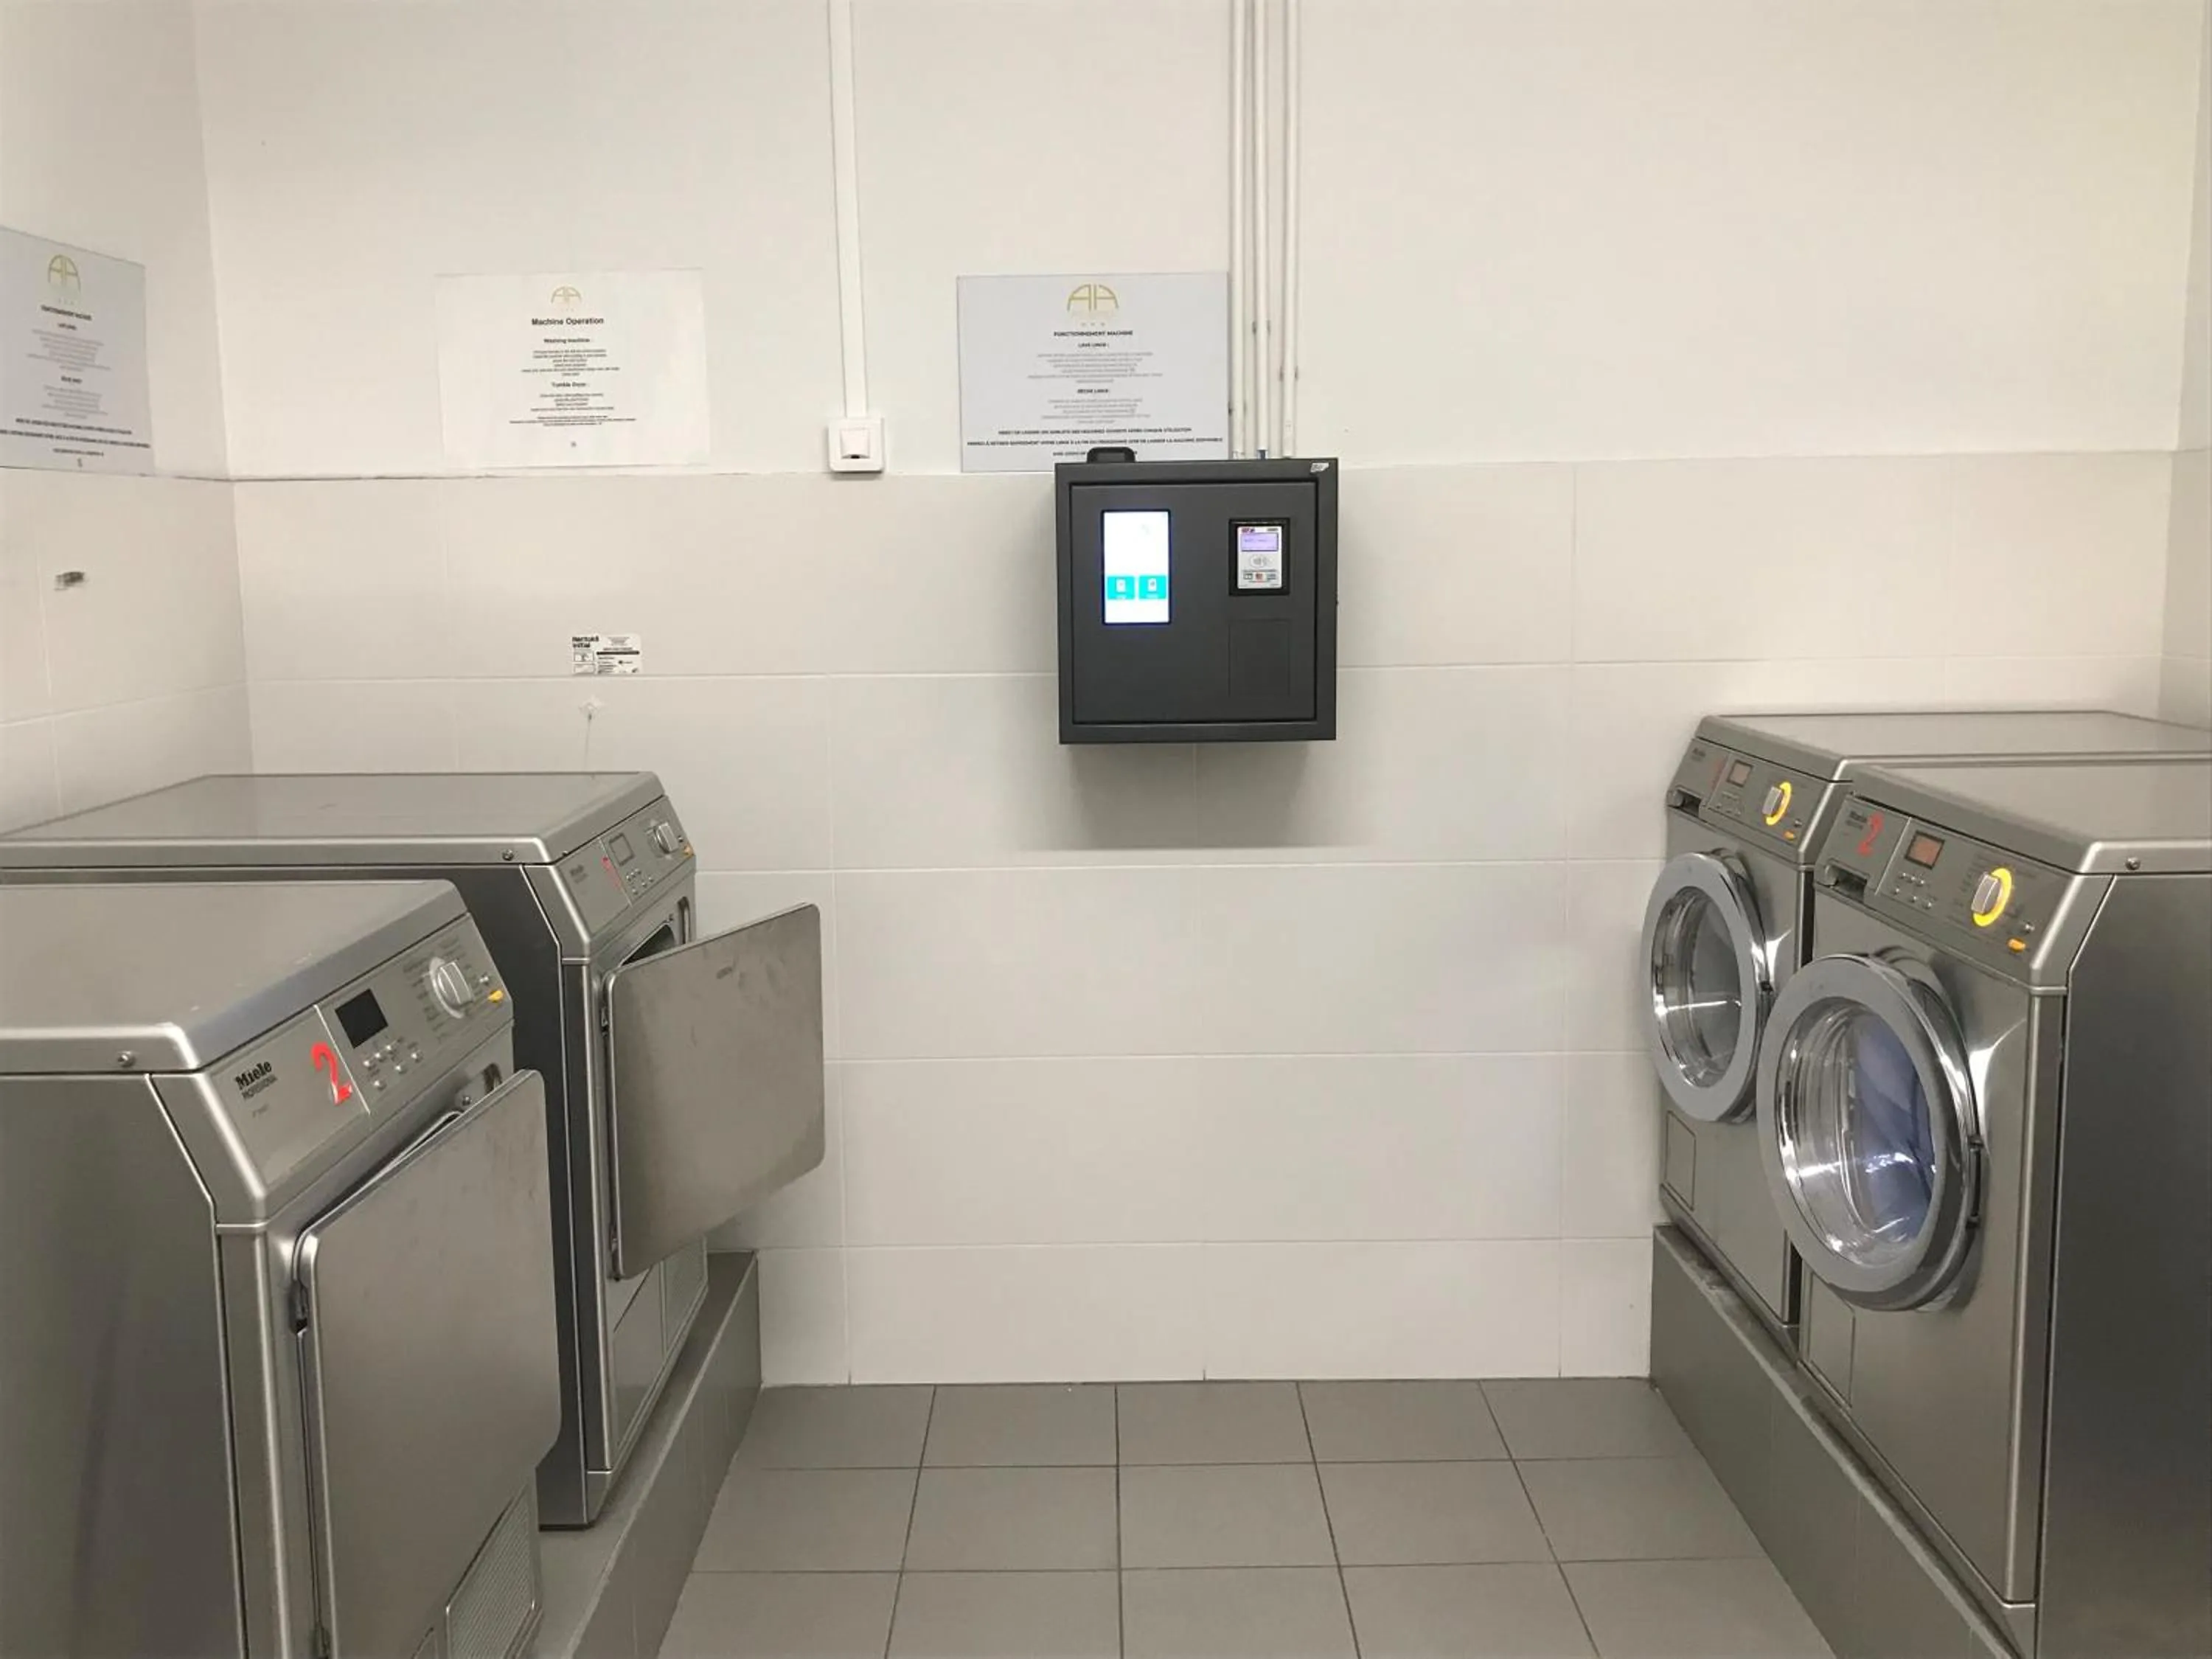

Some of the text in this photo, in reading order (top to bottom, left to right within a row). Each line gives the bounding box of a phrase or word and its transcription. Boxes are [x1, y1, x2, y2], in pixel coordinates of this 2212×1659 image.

[566, 317, 604, 326] Operation
[1856, 810, 1885, 856] 2
[235, 1061, 272, 1090] Miele
[310, 1041, 352, 1105] 2
